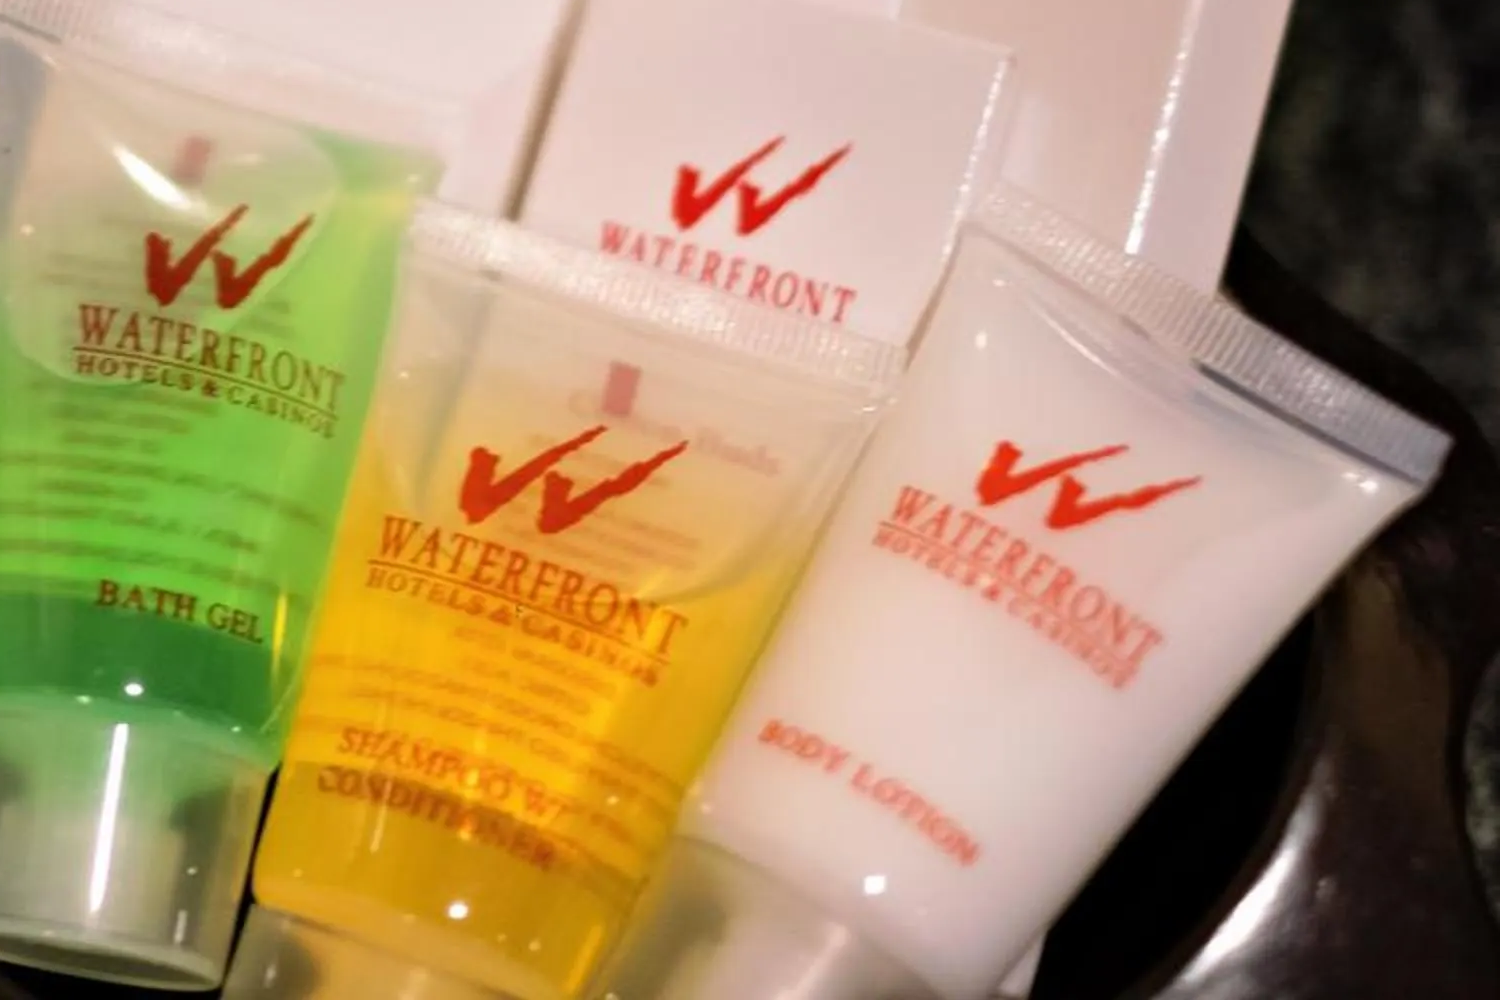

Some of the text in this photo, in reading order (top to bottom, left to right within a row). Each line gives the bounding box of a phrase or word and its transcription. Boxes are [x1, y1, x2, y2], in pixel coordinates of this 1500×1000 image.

[600, 220, 858, 324] WATERFRONT
[75, 354, 195, 392] HOTELS
[78, 303, 347, 413] WATERFRONT
[96, 578, 264, 645] BATH GEL
[365, 566, 487, 617] HOTELS
[378, 514, 690, 656] WATERFRONT
[890, 484, 1164, 668] WATERFRONT
[758, 719, 851, 774] BODY
[851, 763, 980, 867] LOTION
